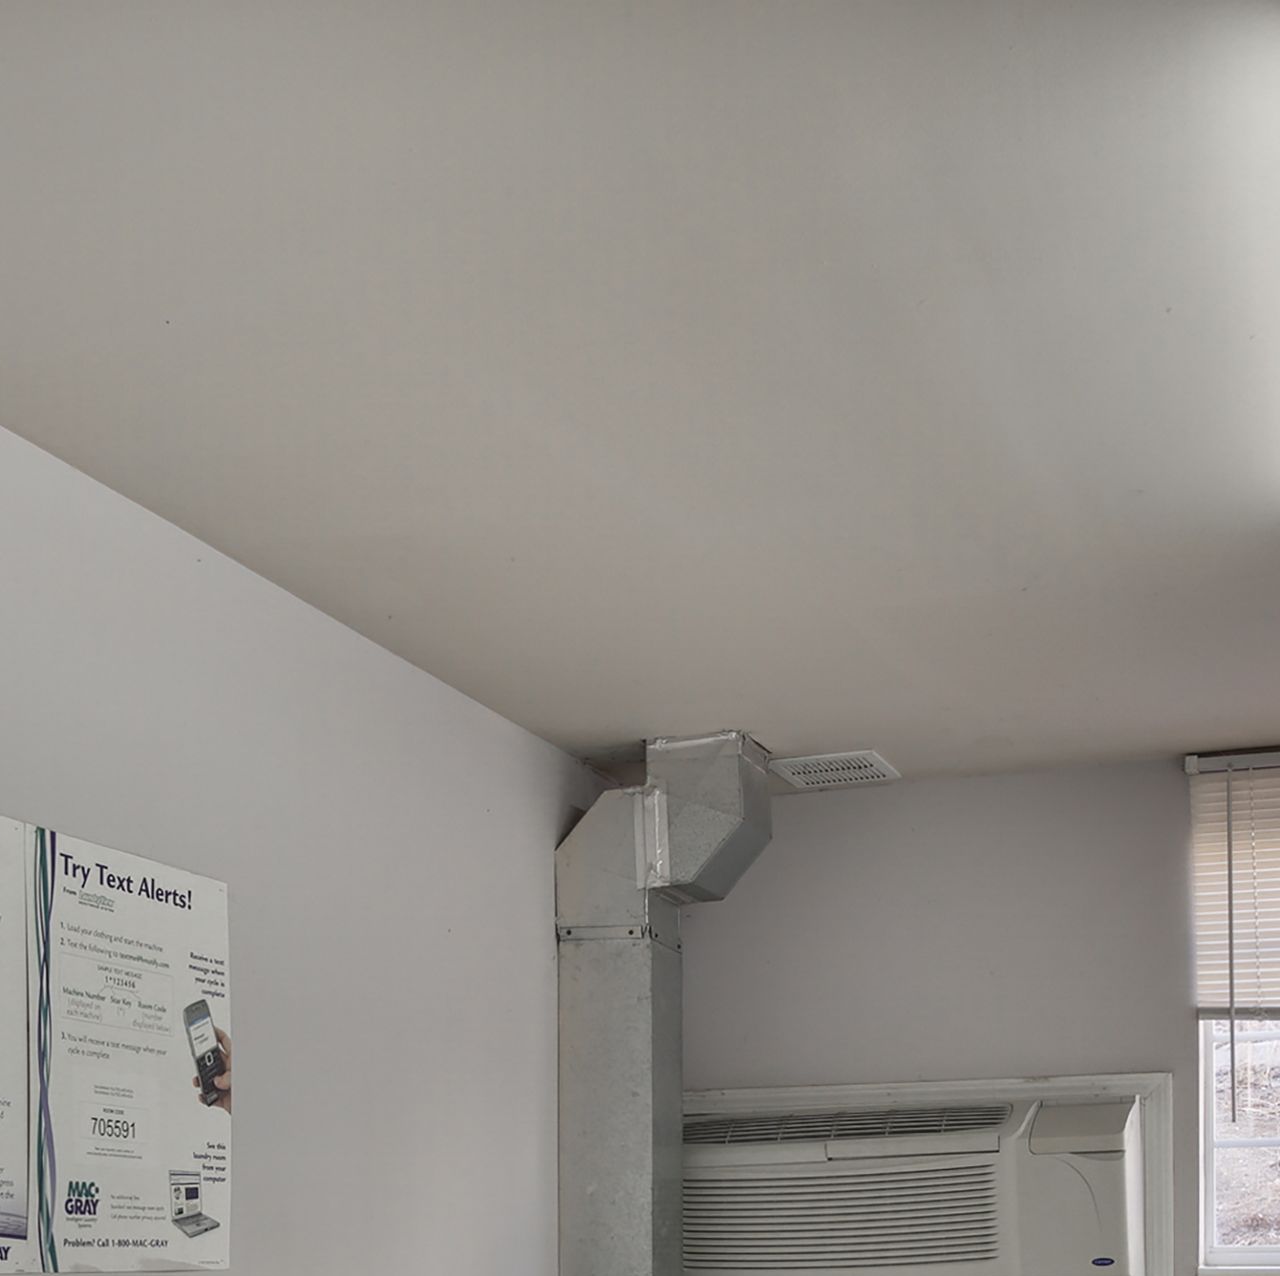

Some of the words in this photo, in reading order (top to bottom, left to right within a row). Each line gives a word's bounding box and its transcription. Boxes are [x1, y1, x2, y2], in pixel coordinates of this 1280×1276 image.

[58, 851, 91, 889] Try
[94, 861, 134, 894] Text
[136, 876, 192, 911] Alerts!
[61, 885, 77, 896] From
[90, 1115, 136, 1139] 705591
[63, 1197, 100, 1216] GRAY
[62, 1237, 96, 1248] Problem?
[95, 1237, 110, 1248] Call
[110, 1237, 168, 1248] 1-800-MAC-GRAY
